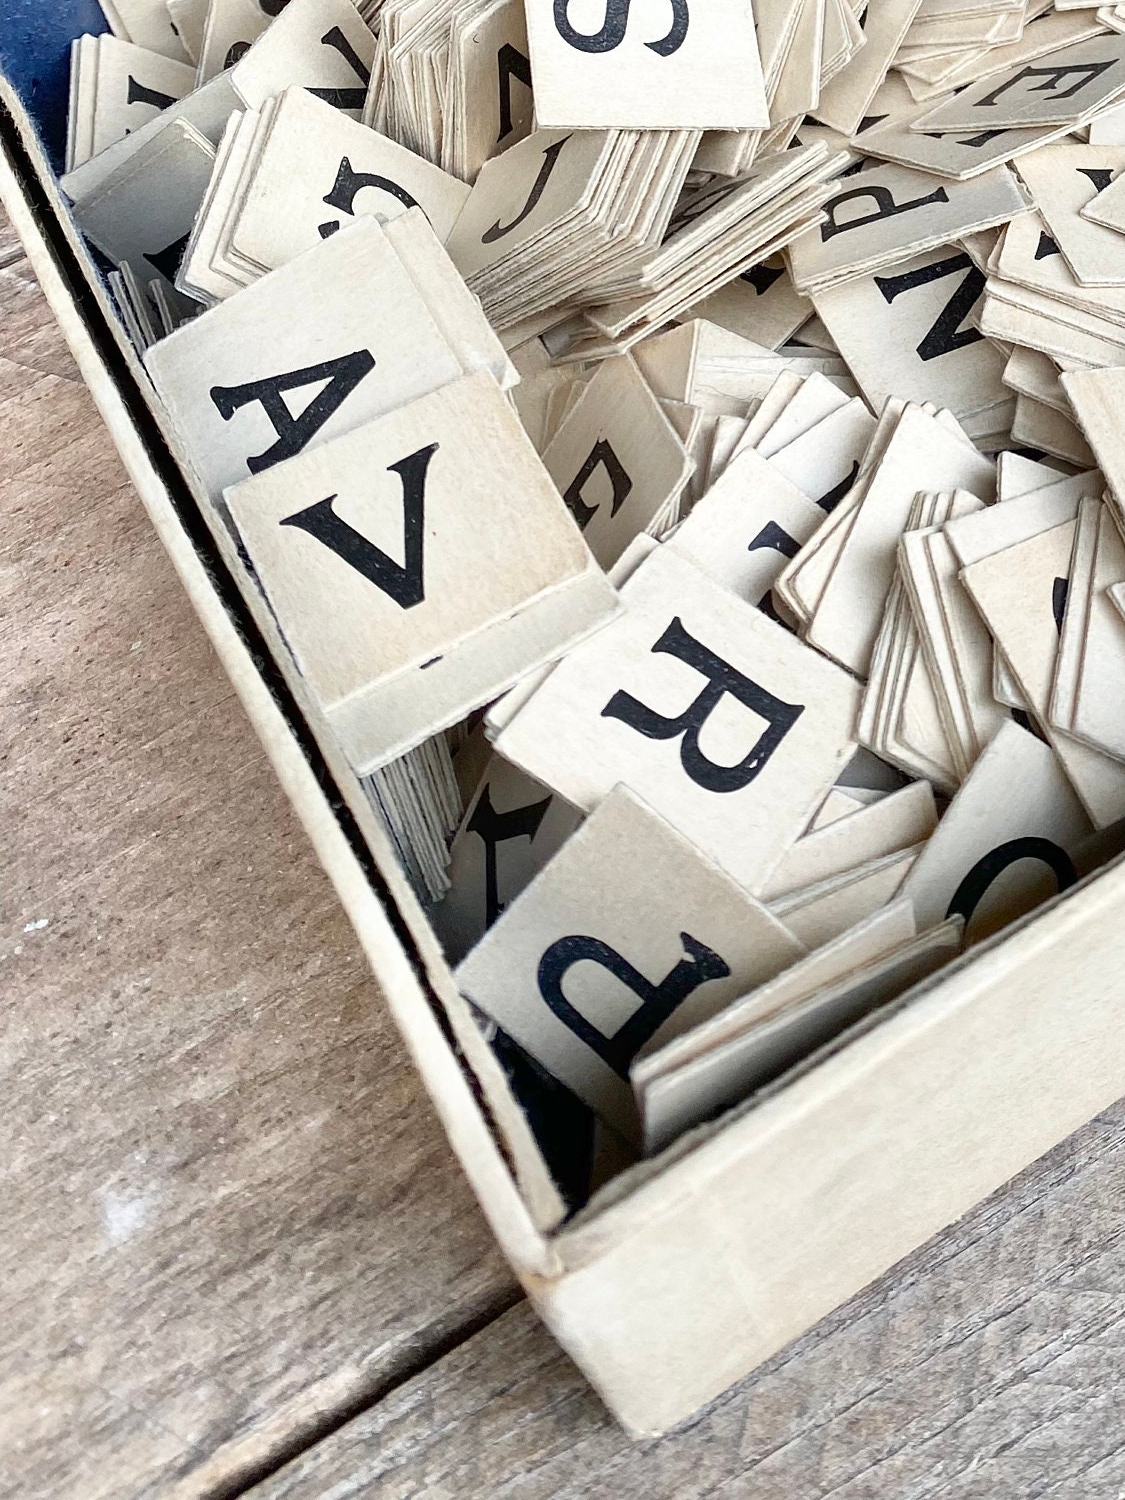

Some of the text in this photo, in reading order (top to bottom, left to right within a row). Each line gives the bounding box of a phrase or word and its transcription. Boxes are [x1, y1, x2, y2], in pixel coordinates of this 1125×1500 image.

[973, 58, 1120, 107] E
[821, 184, 950, 244] P
[210, 349, 377, 476] A
[279, 443, 440, 611] V
[600, 615, 806, 794] R
